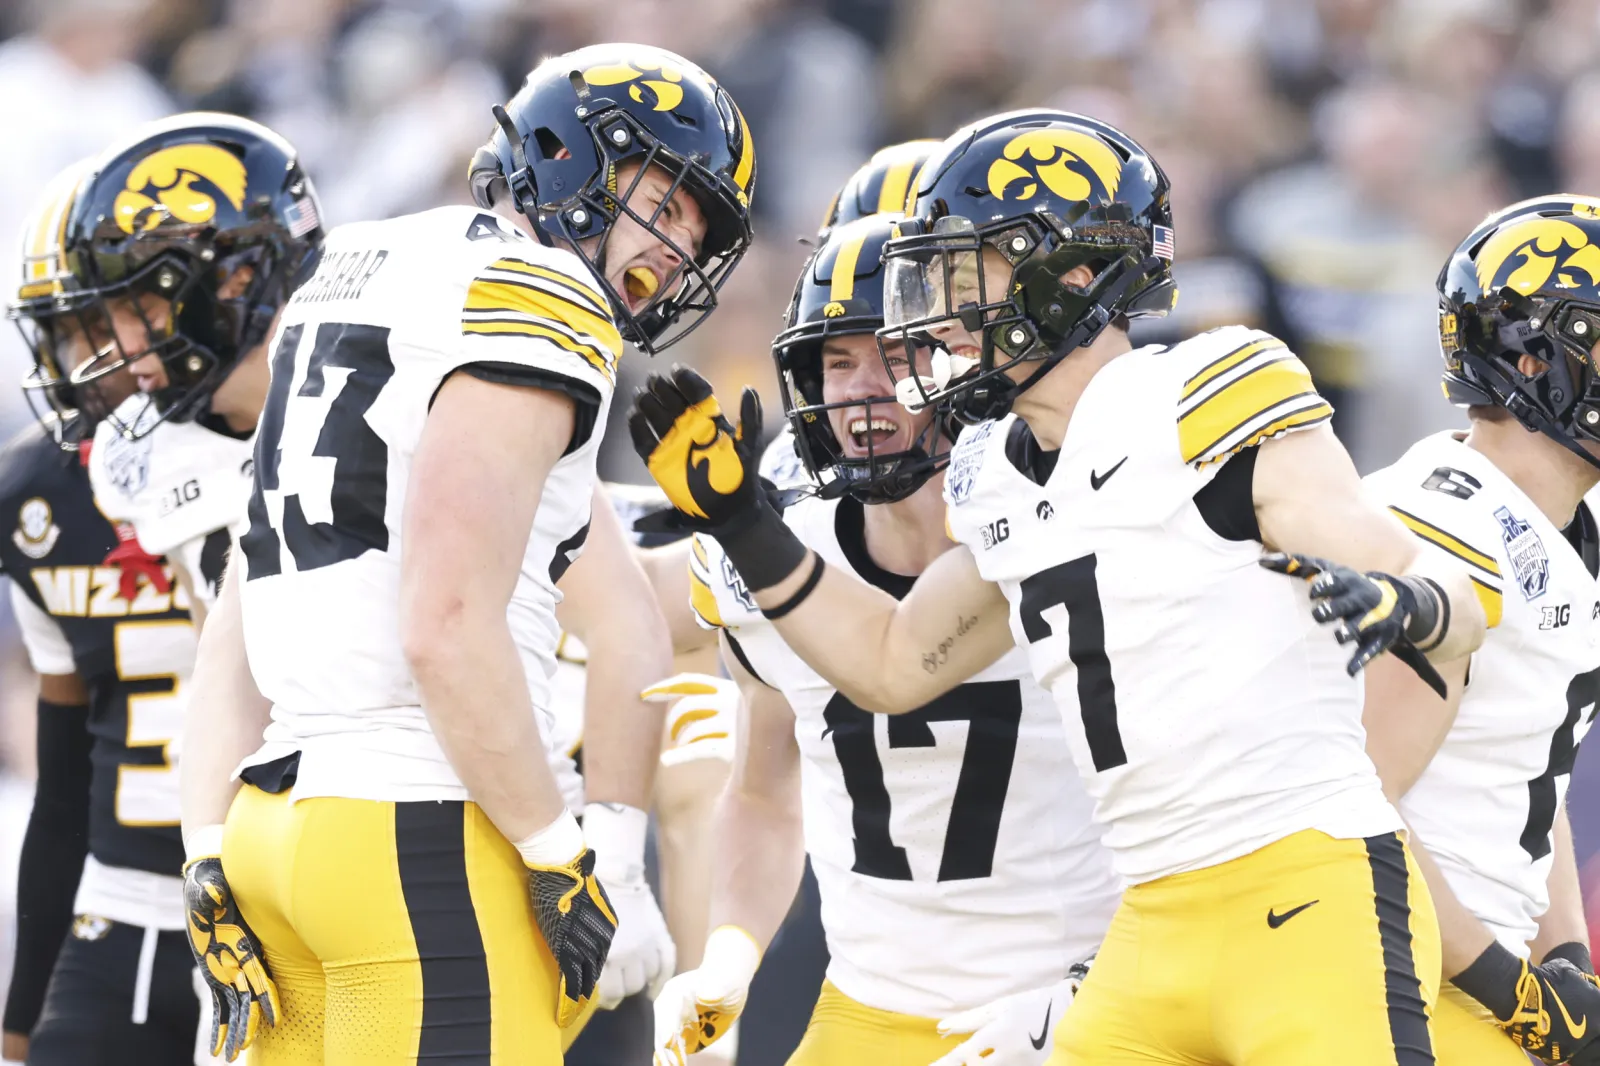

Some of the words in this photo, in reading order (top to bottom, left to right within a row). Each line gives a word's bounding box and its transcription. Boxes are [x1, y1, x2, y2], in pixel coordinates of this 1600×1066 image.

[979, 517, 1010, 551] BIG
[31, 565, 192, 618] MIZZ
[1539, 604, 1570, 630] BIG
[1020, 552, 1128, 773] 7
[821, 679, 1023, 883] 17
